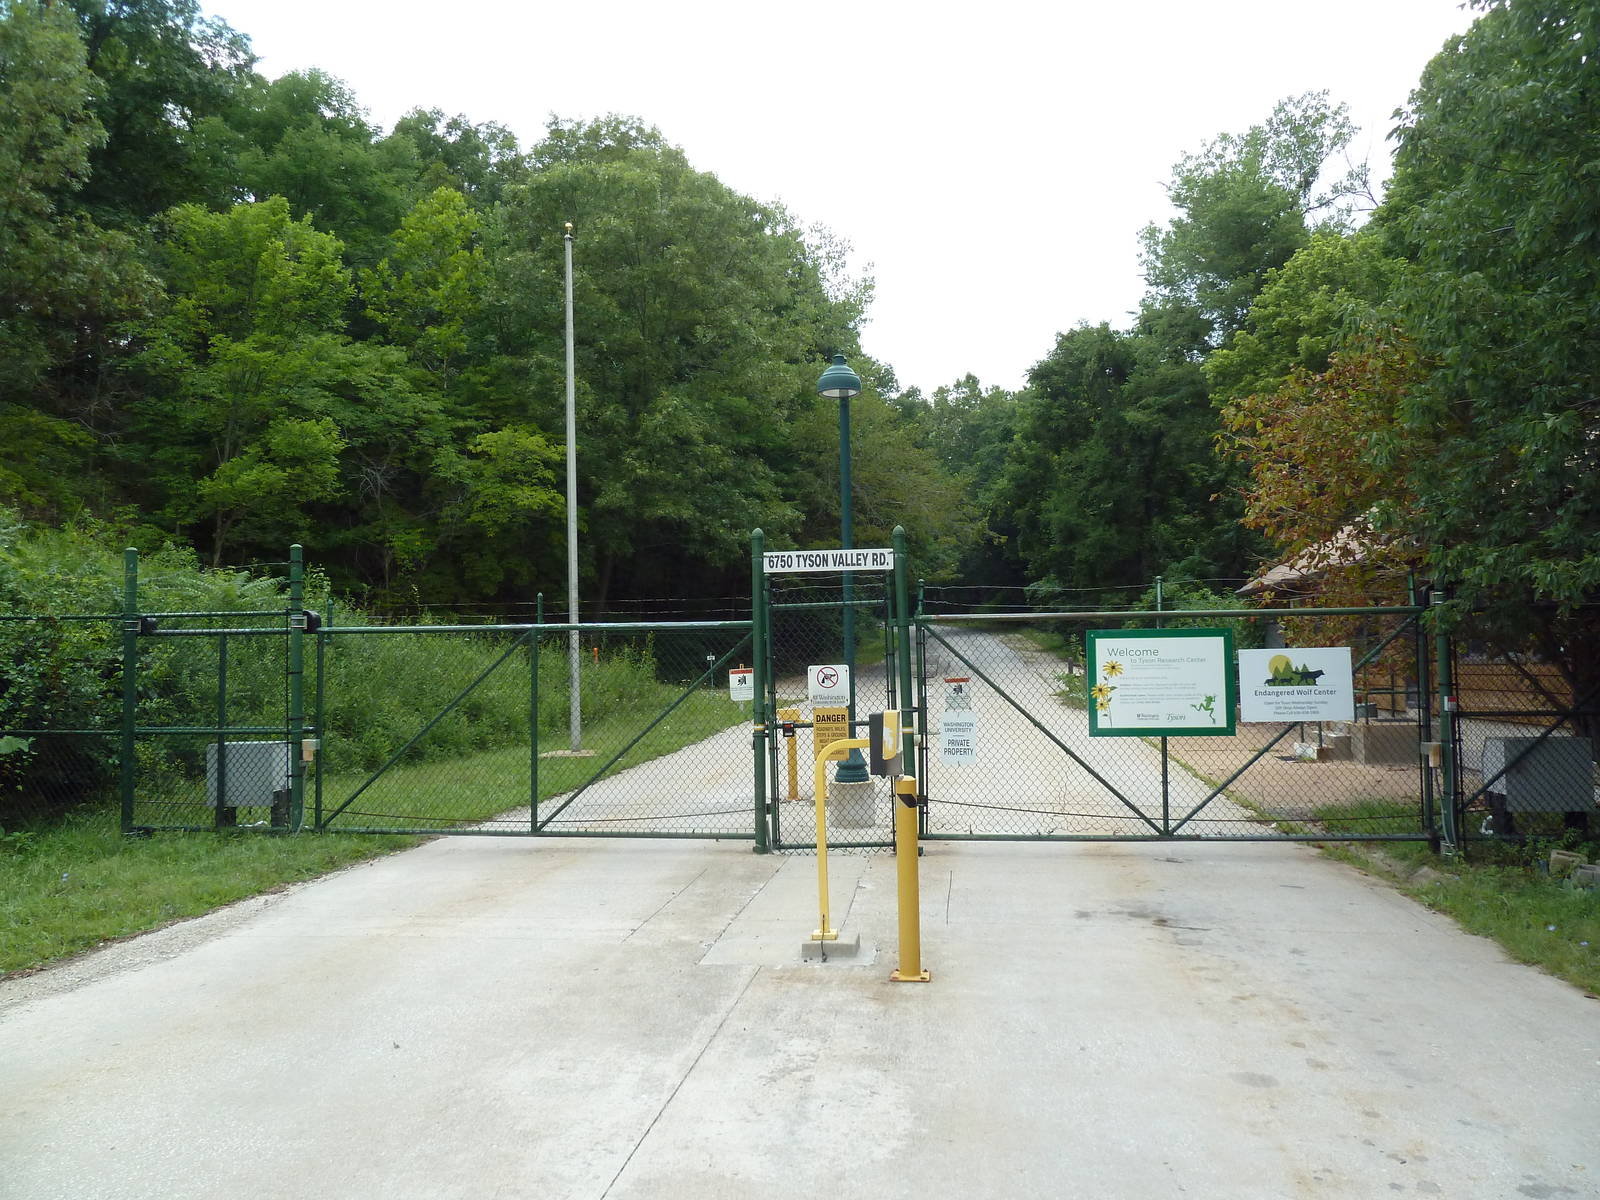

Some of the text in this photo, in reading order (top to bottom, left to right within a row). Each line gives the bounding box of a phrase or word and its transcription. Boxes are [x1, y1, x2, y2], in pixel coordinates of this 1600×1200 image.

[768, 552, 889, 569] 6750 TYSON VALLEY RD.
[1107, 647, 1159, 657] Welcome
[1254, 688, 1337, 697] Endangered Wolf Center
[816, 714, 846, 722] DANGER
[947, 738, 970, 747] PRIVATE
[943, 748, 974, 756] PROPERTY
